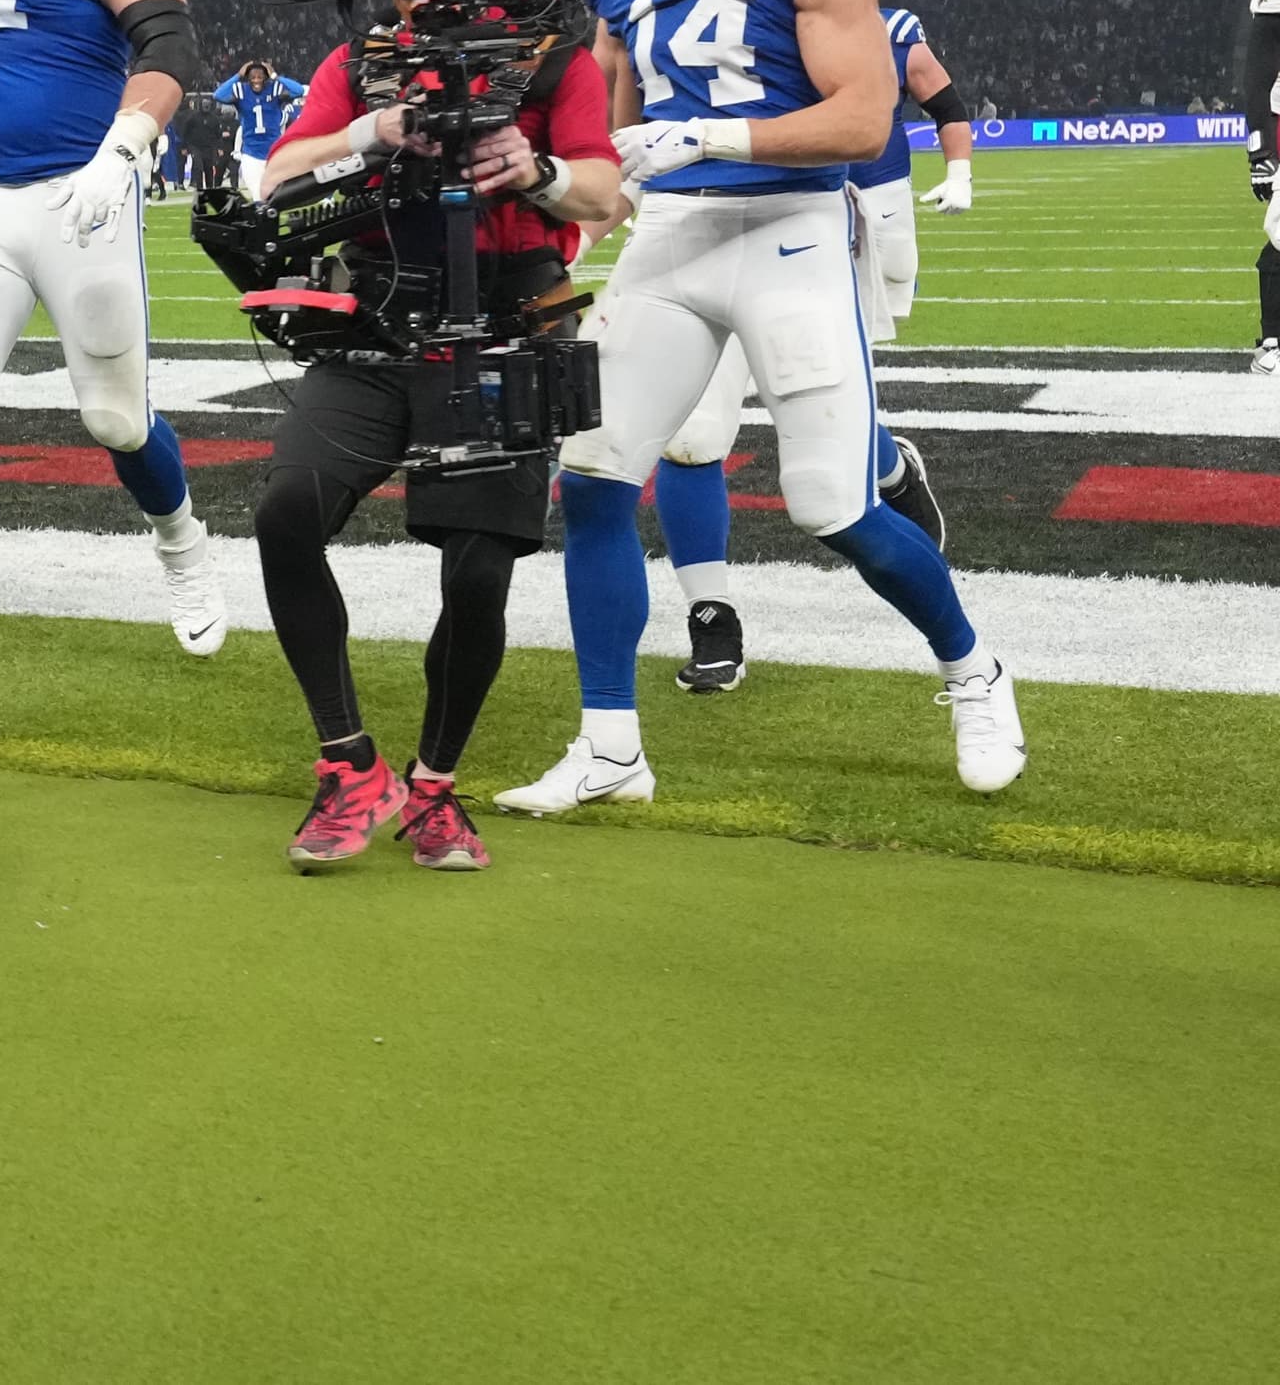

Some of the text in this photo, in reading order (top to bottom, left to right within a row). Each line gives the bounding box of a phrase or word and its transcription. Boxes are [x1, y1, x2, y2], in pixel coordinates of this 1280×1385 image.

[252, 105, 267, 134] 1
[1063, 118, 1246, 143] NetApp WITH
